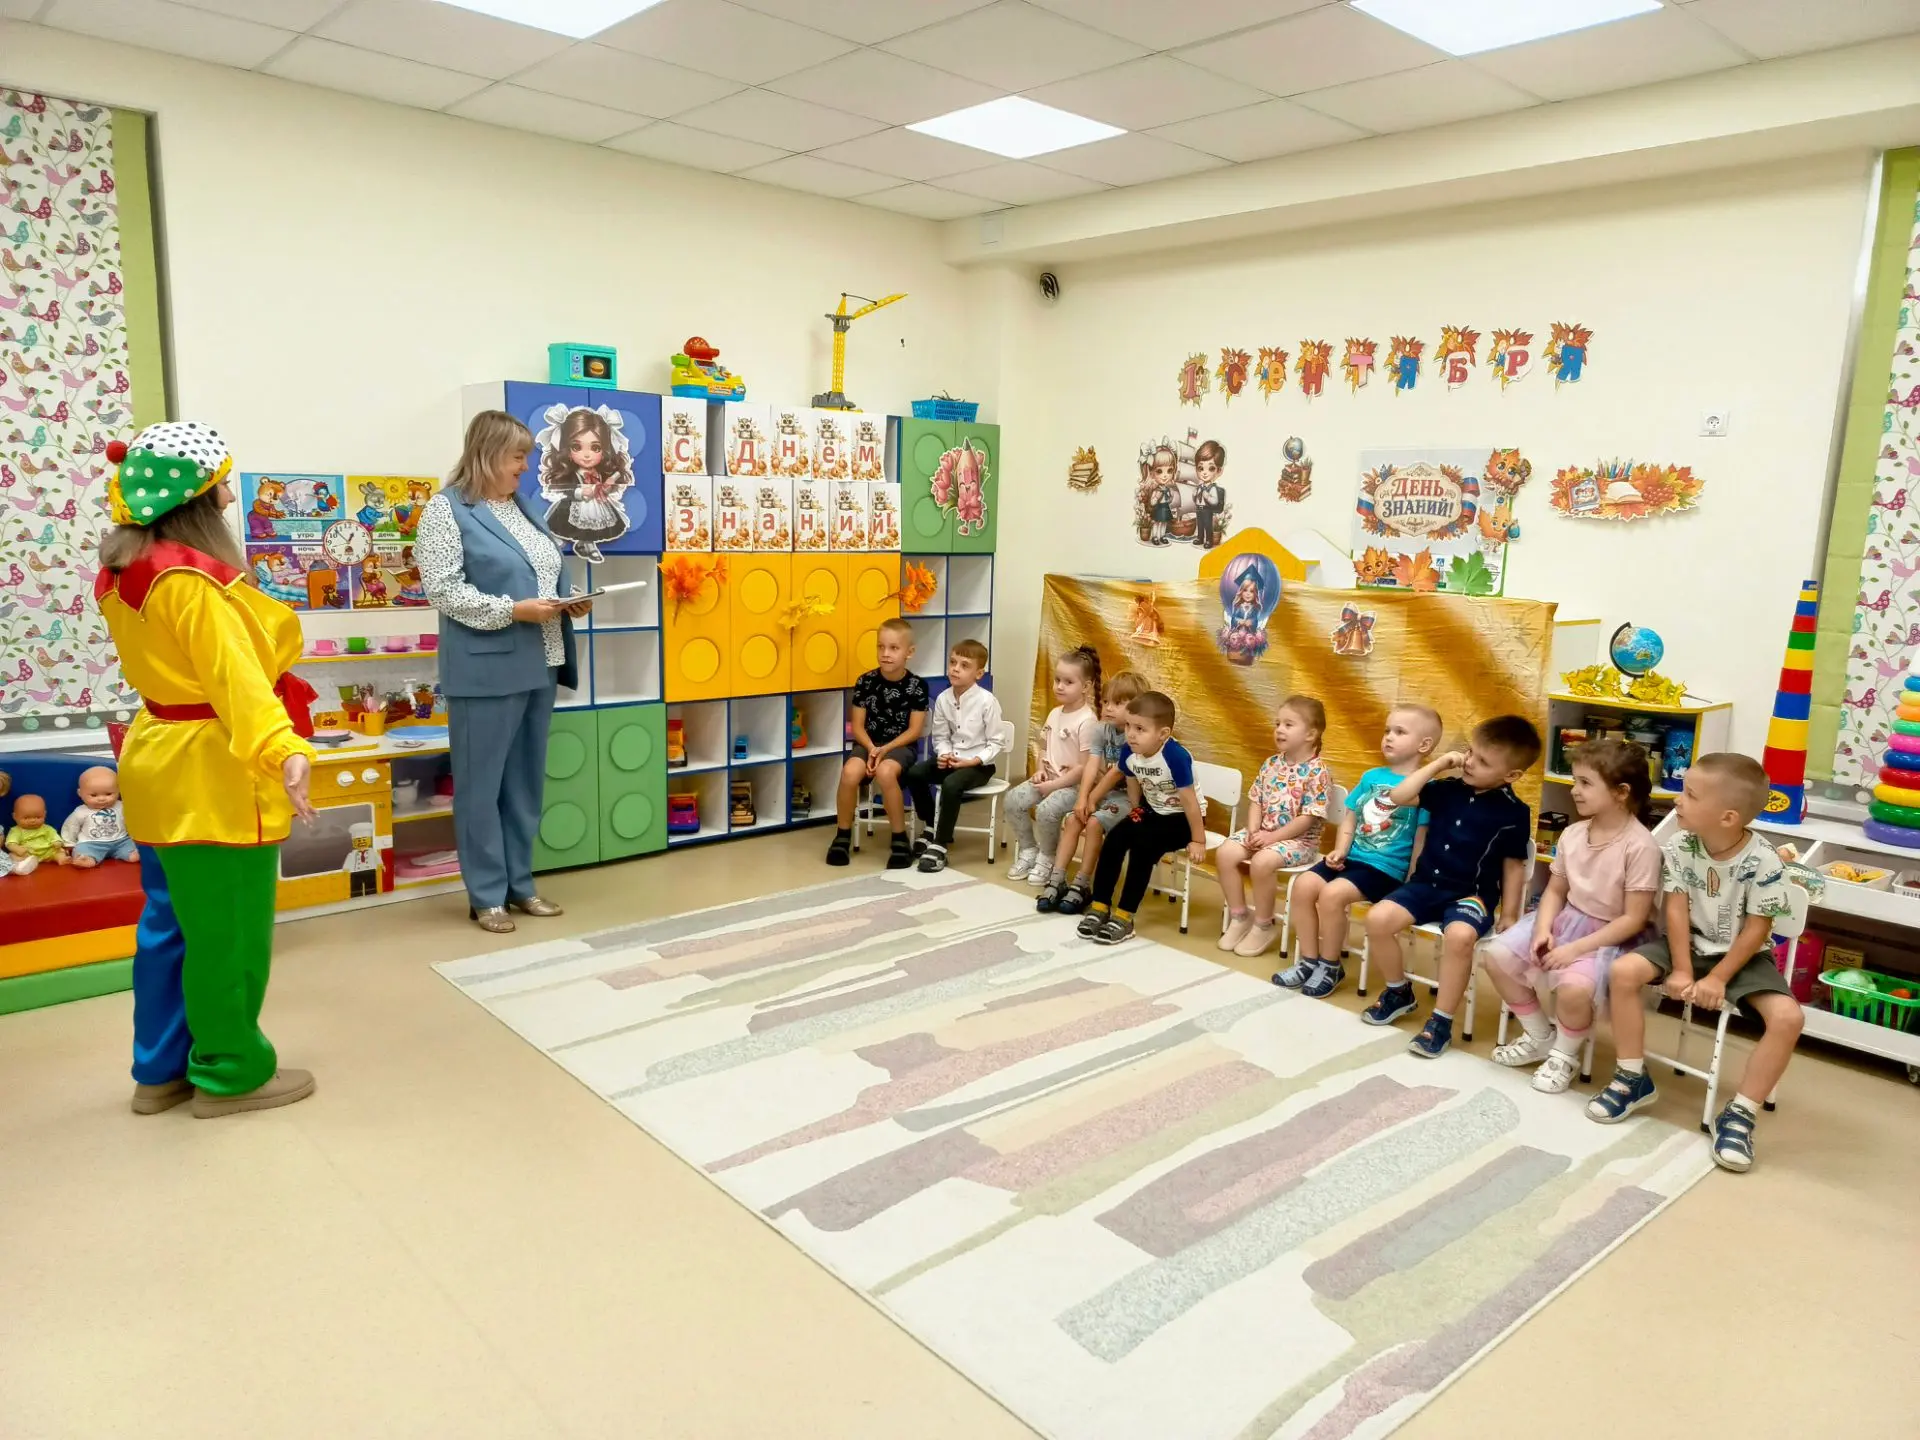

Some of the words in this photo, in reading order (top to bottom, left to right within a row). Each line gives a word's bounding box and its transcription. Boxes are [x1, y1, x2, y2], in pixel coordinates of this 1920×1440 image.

[736, 439, 875, 474] Днём
[1392, 478, 1444, 499] ДЕНЬ
[1383, 498, 1454, 518] ЗНАНИЙ!
[679, 508, 893, 535] Знаний!
